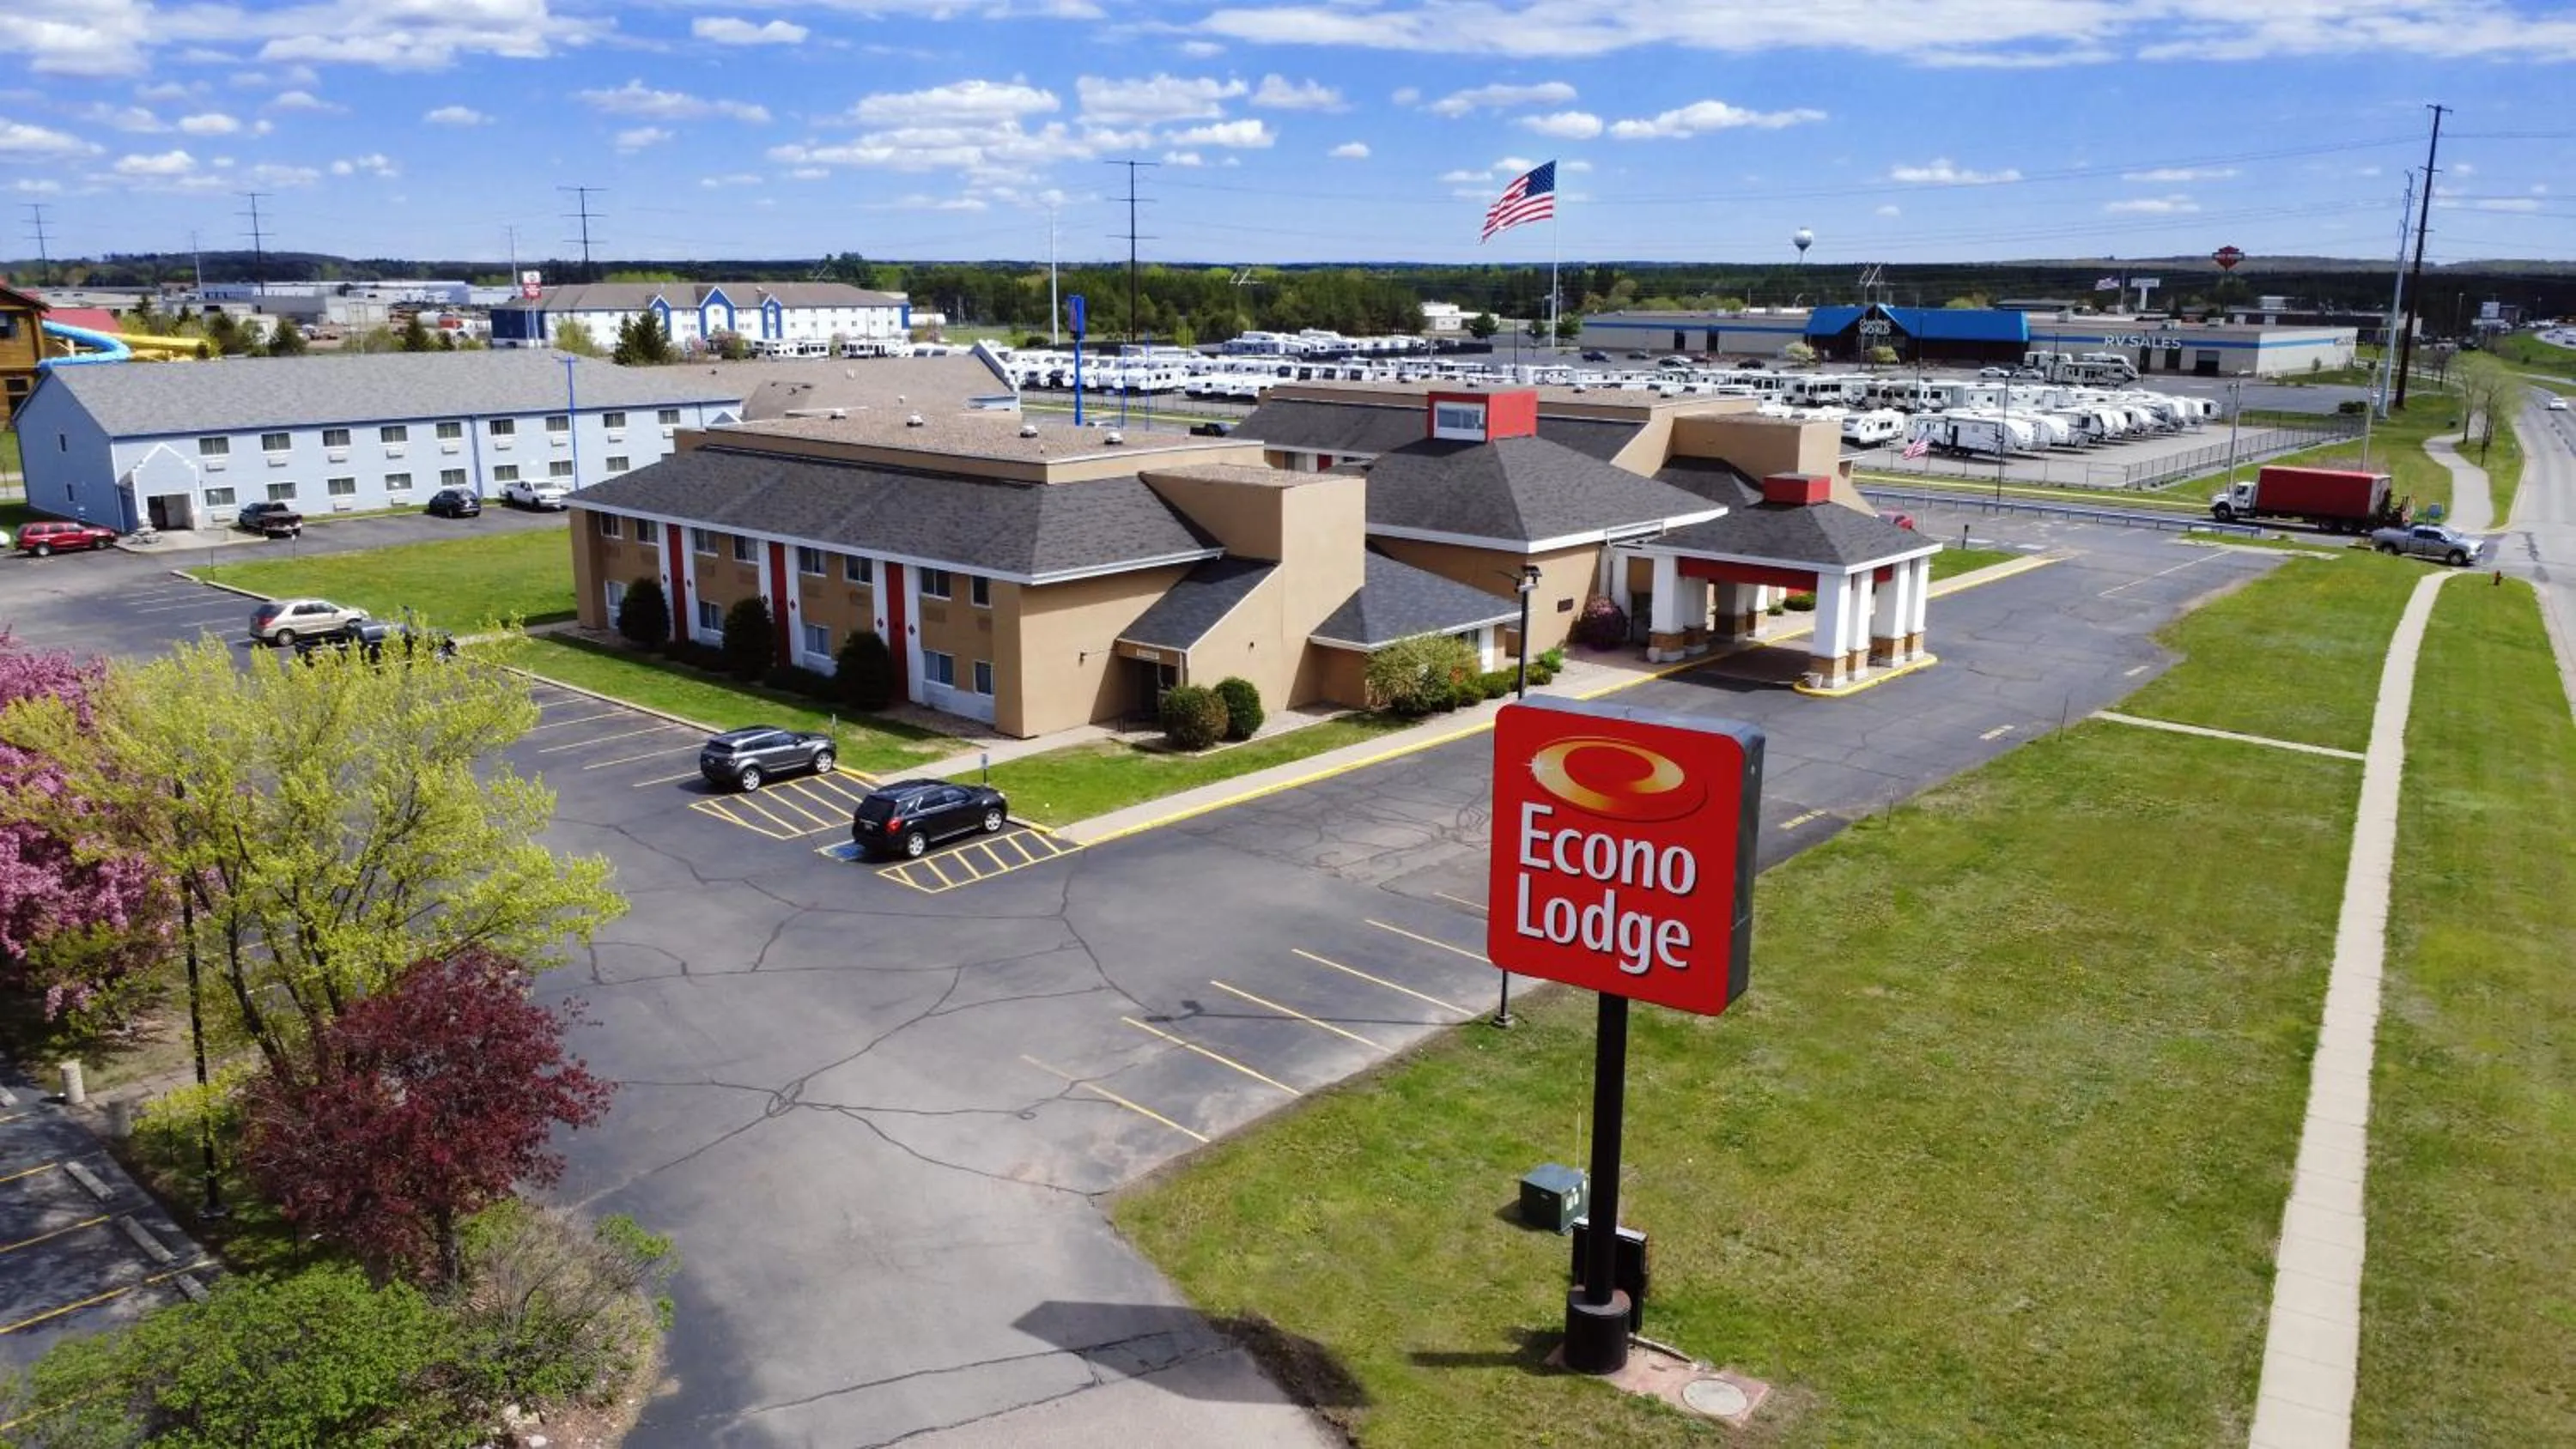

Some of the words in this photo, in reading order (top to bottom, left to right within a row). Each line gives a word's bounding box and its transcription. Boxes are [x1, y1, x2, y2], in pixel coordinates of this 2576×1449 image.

[2105, 335, 2127, 348] RV
[2129, 336, 2181, 349] SALES
[1519, 800, 1696, 895] Econo
[1516, 872, 1690, 975] Lodge
